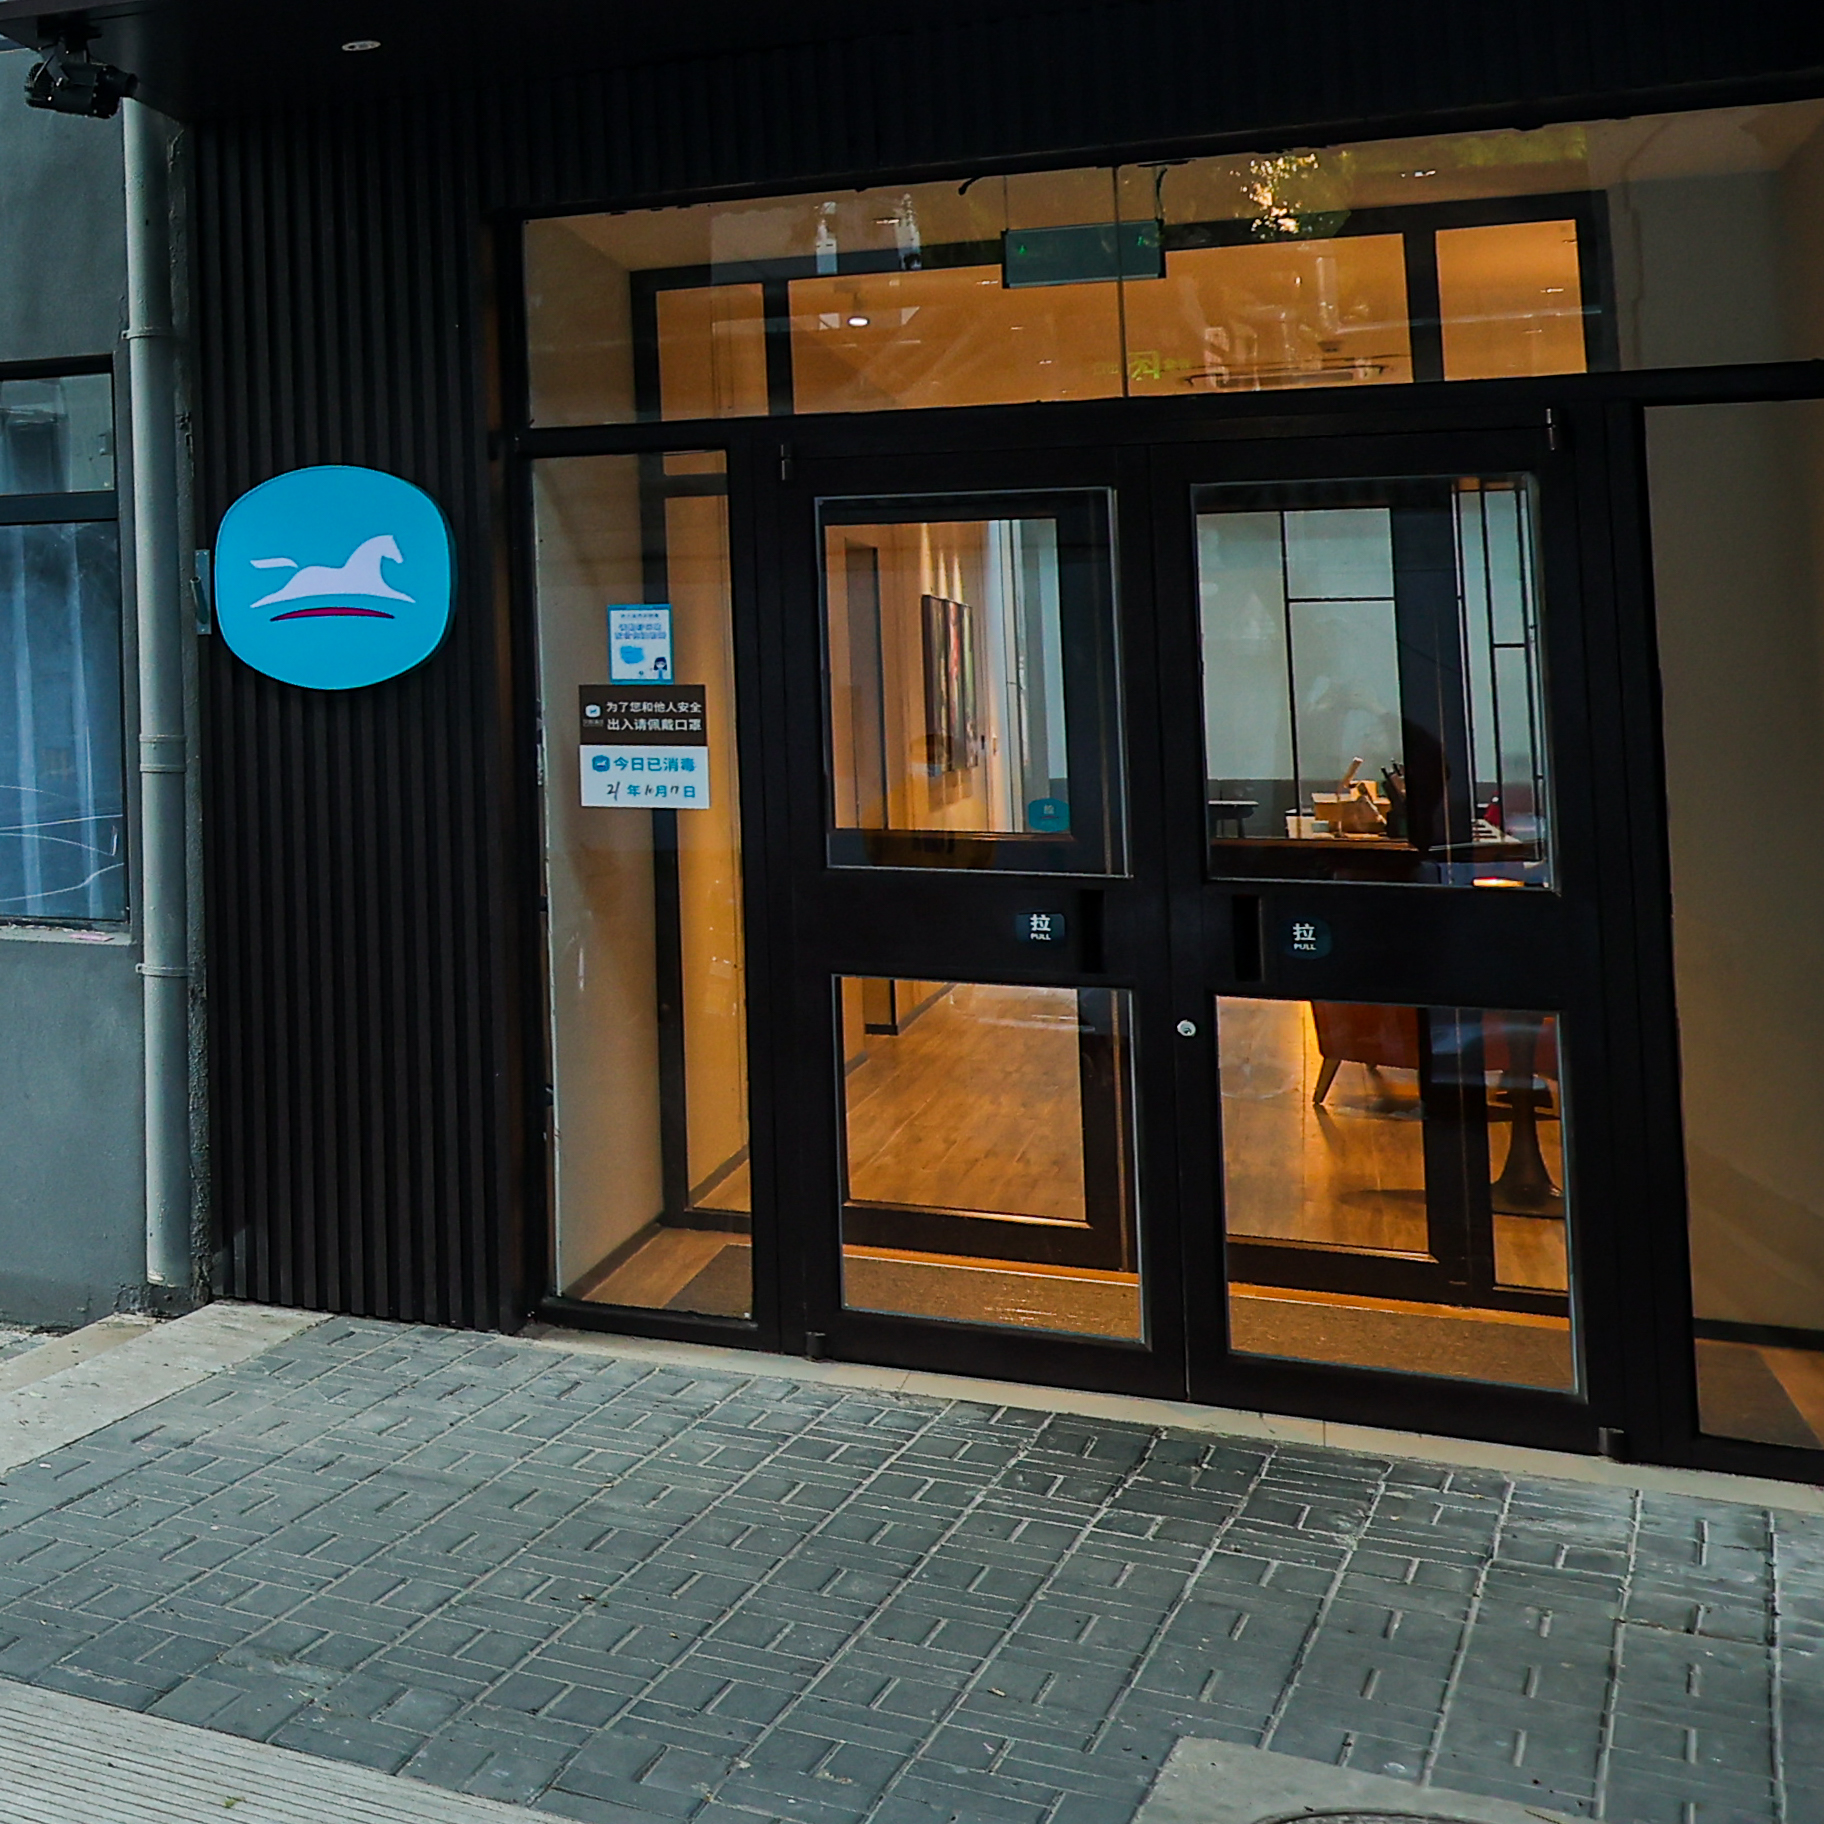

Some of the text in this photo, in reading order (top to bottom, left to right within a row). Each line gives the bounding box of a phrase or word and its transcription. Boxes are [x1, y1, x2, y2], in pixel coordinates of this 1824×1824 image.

[606, 702, 702, 713] 为了您和他人安全
[607, 719, 702, 731] 出入请佩戴口罩
[613, 757, 696, 772] 今日已消毒
[1030, 913, 1051, 931] 拉
[1292, 922, 1316, 941] 拉
